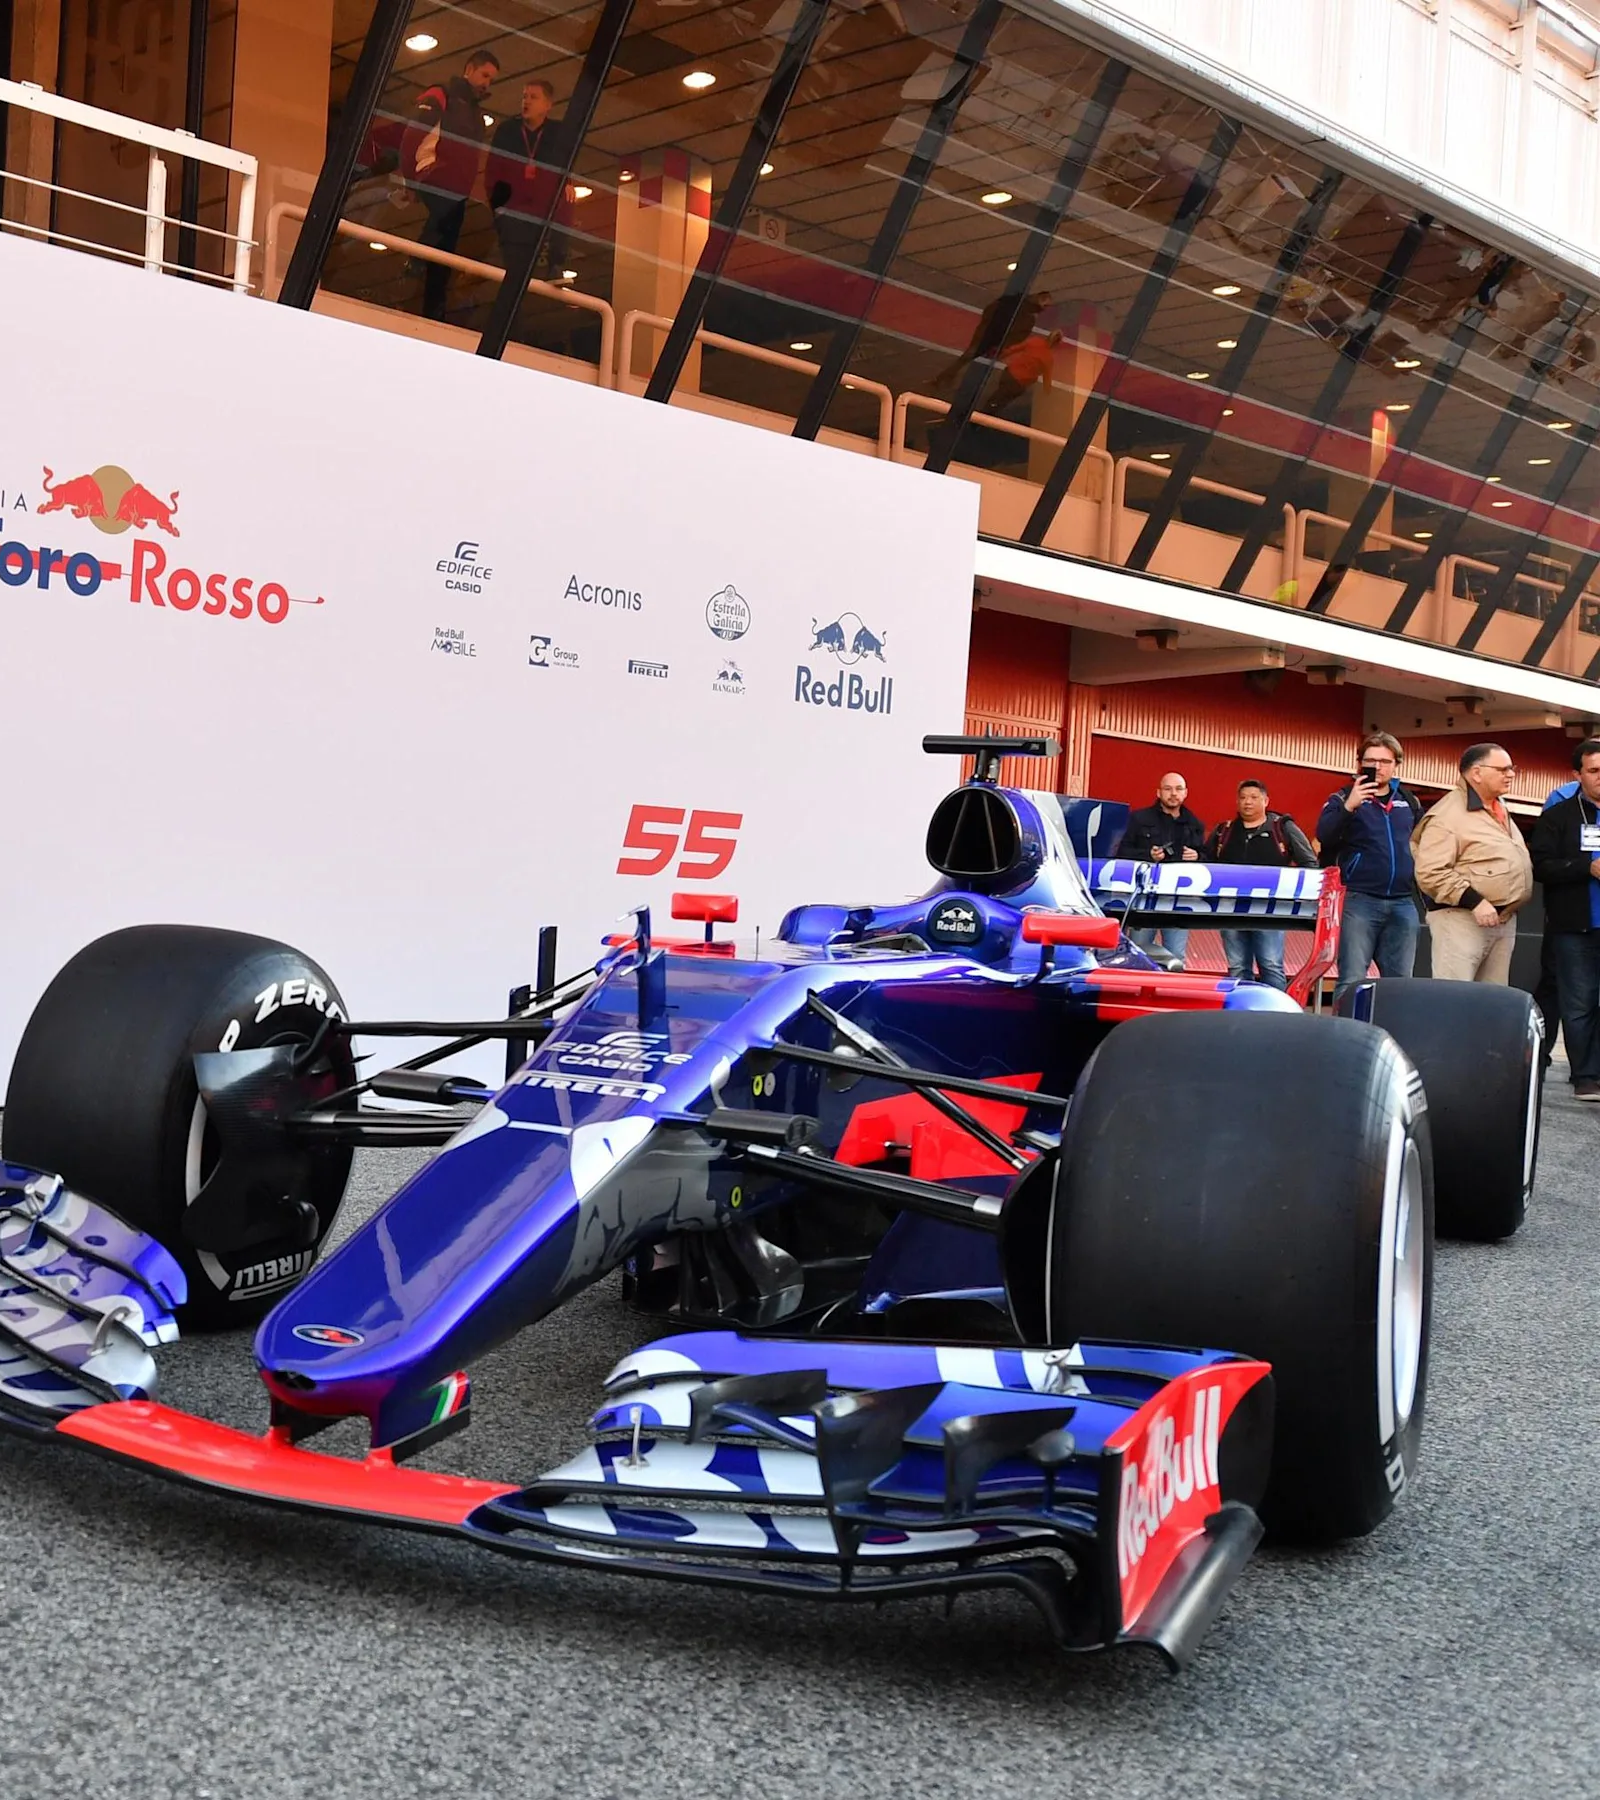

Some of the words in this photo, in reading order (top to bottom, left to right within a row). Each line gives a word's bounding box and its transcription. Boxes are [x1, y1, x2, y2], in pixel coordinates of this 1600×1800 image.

[436, 560, 493, 580] EDIFICE
[130, 538, 290, 625] Rosso
[445, 579, 482, 594] CASIO
[563, 574, 642, 611] Acronis
[712, 600, 747, 618] Estrella
[435, 627, 450, 639] Red
[450, 629, 464, 641] Bull
[553, 647, 578, 663] Group
[628, 659, 669, 679] PIRELLI
[795, 665, 844, 708] Red
[847, 673, 893, 714] Bull
[616, 804, 743, 879] 55
[936, 920, 956, 931] Red
[957, 921, 976, 933] Bull
[548, 1041, 693, 1065] EDIFICE
[558, 1054, 653, 1073] CASIO
[1159, 1385, 1222, 1520] Bull
